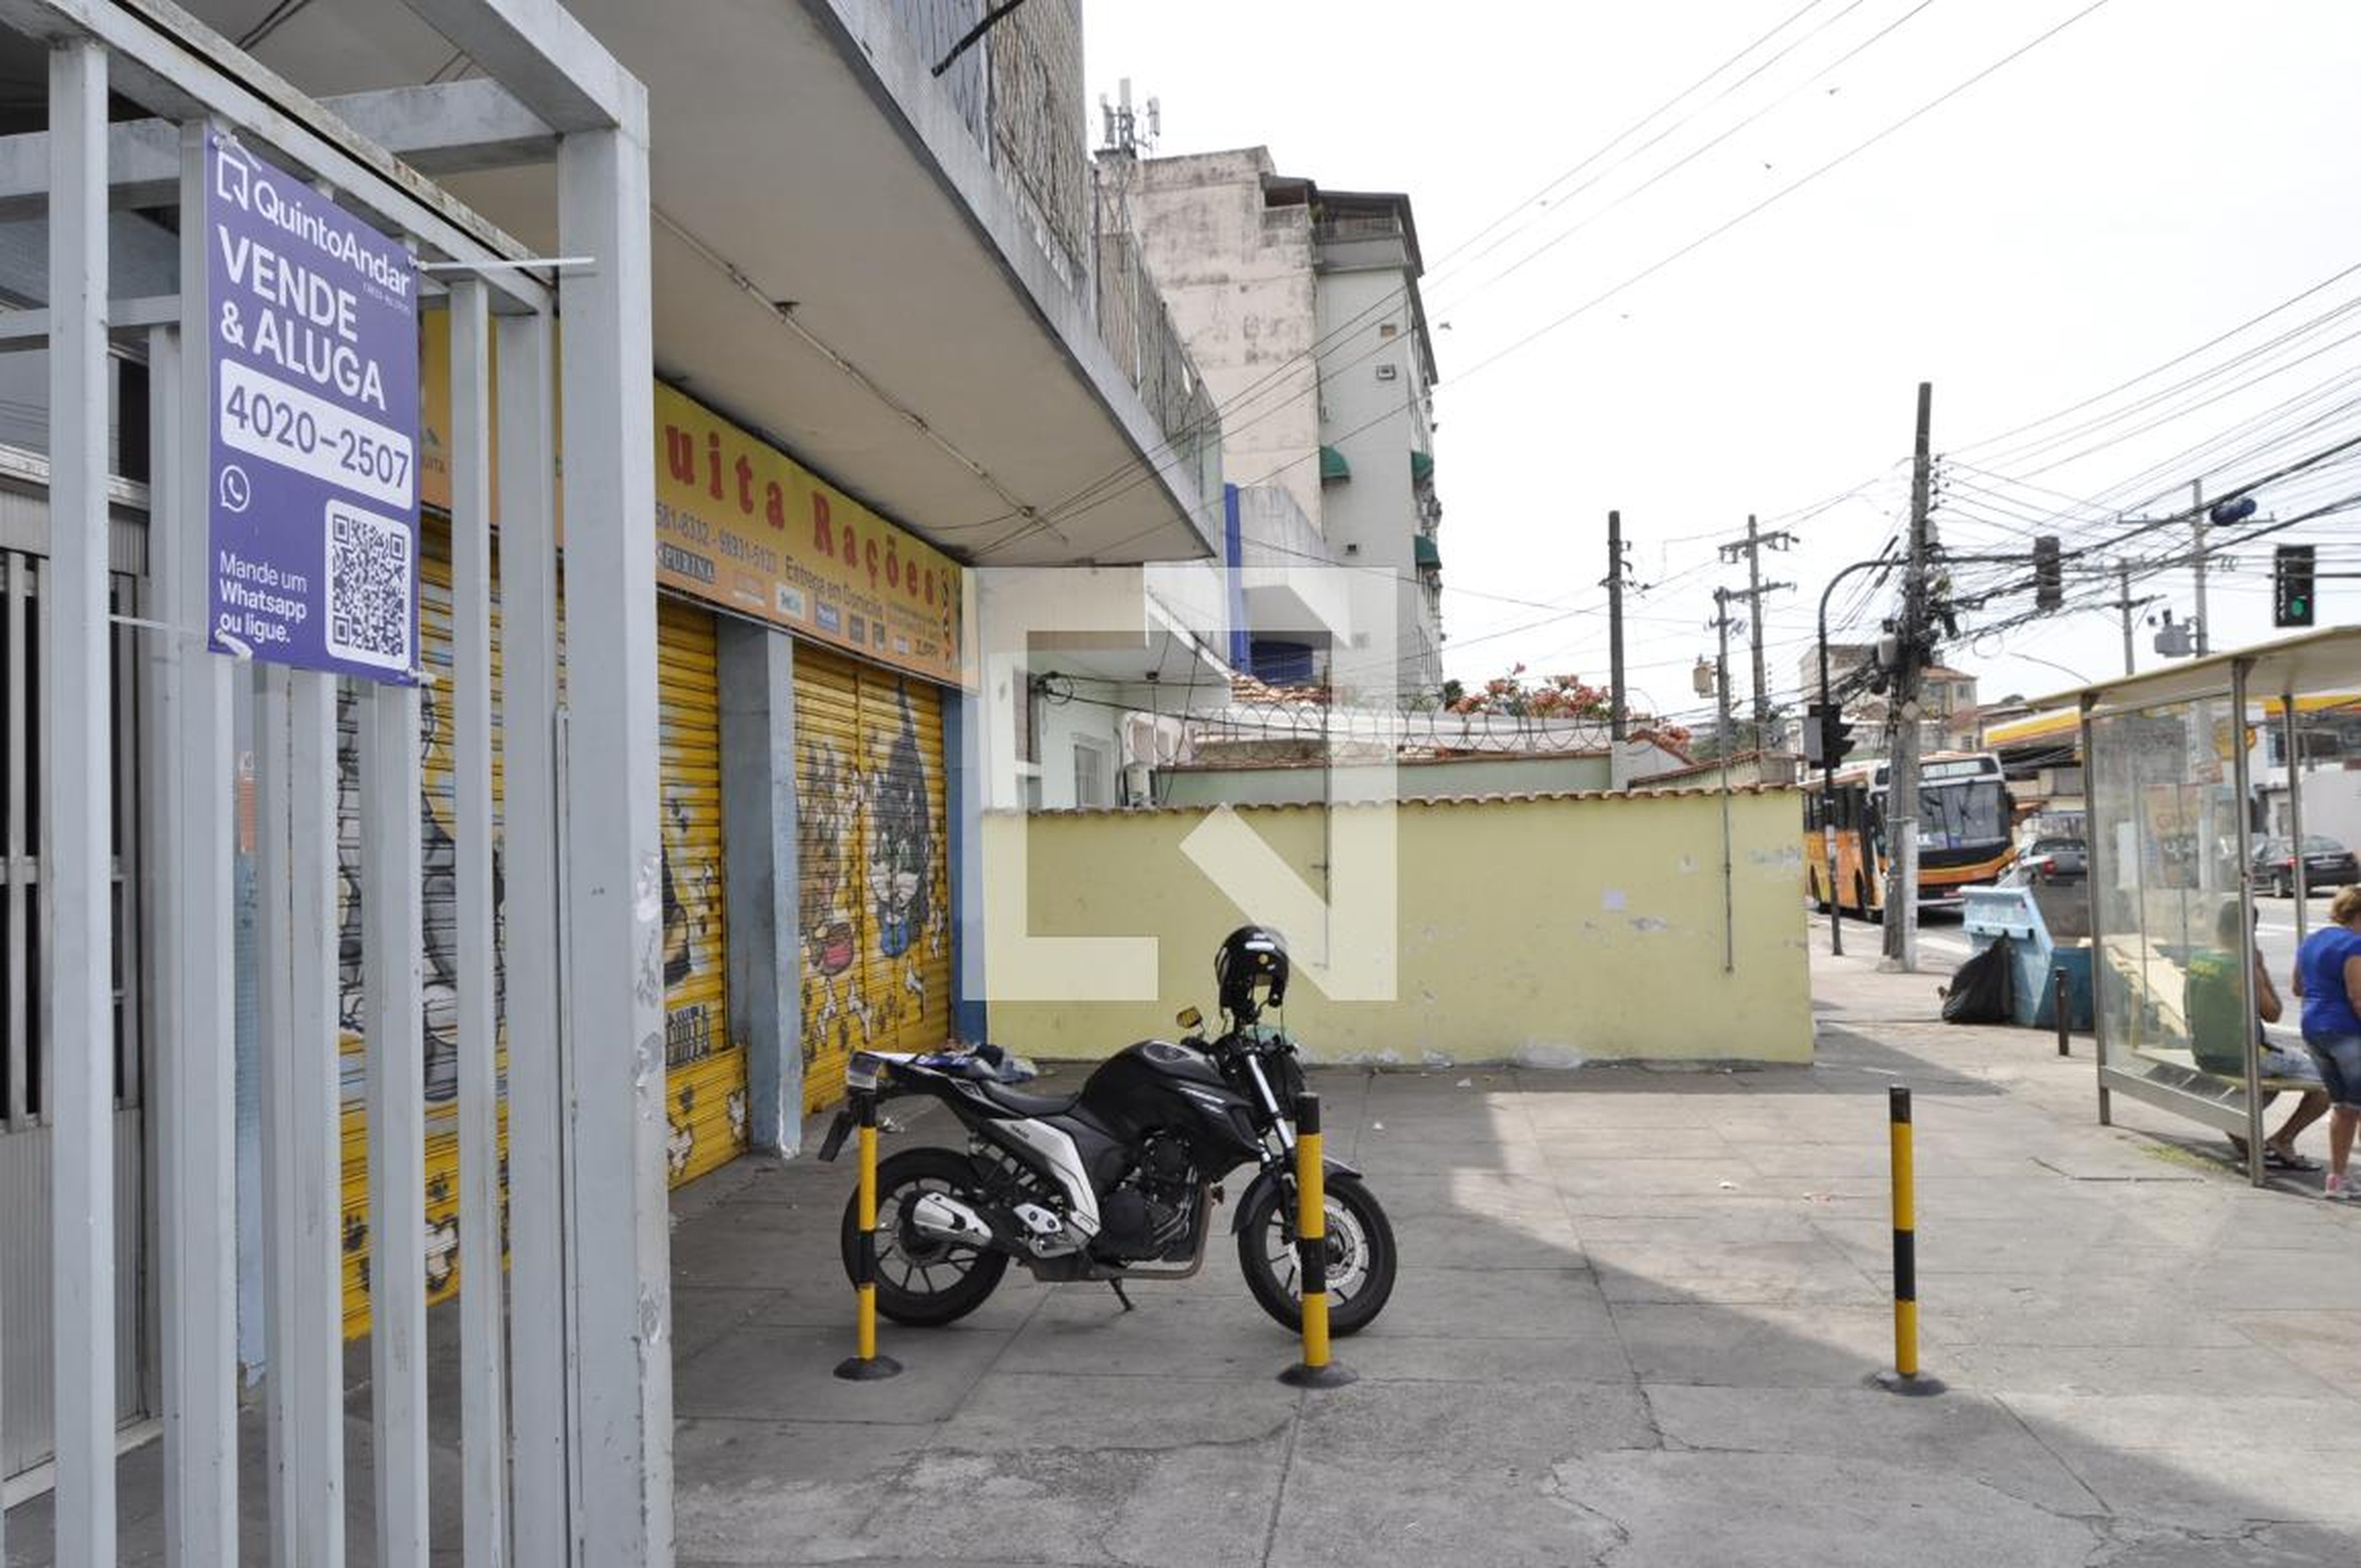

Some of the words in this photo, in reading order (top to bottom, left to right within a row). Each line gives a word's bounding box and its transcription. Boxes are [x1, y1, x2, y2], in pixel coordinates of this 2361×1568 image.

[218, 224, 358, 342] VENDE
[255, 180, 409, 296] QuintoAndar
[221, 299, 245, 349] &
[253, 309, 384, 411] ALUGA
[226, 385, 409, 488] 4020-2507
[219, 552, 279, 586] Mande
[281, 569, 307, 593] um
[663, 546, 714, 582] PURINA
[813, 492, 935, 605] Rações
[219, 580, 307, 624] Whatsapp
[220, 612, 241, 632] ou
[246, 614, 291, 644] ligue.
